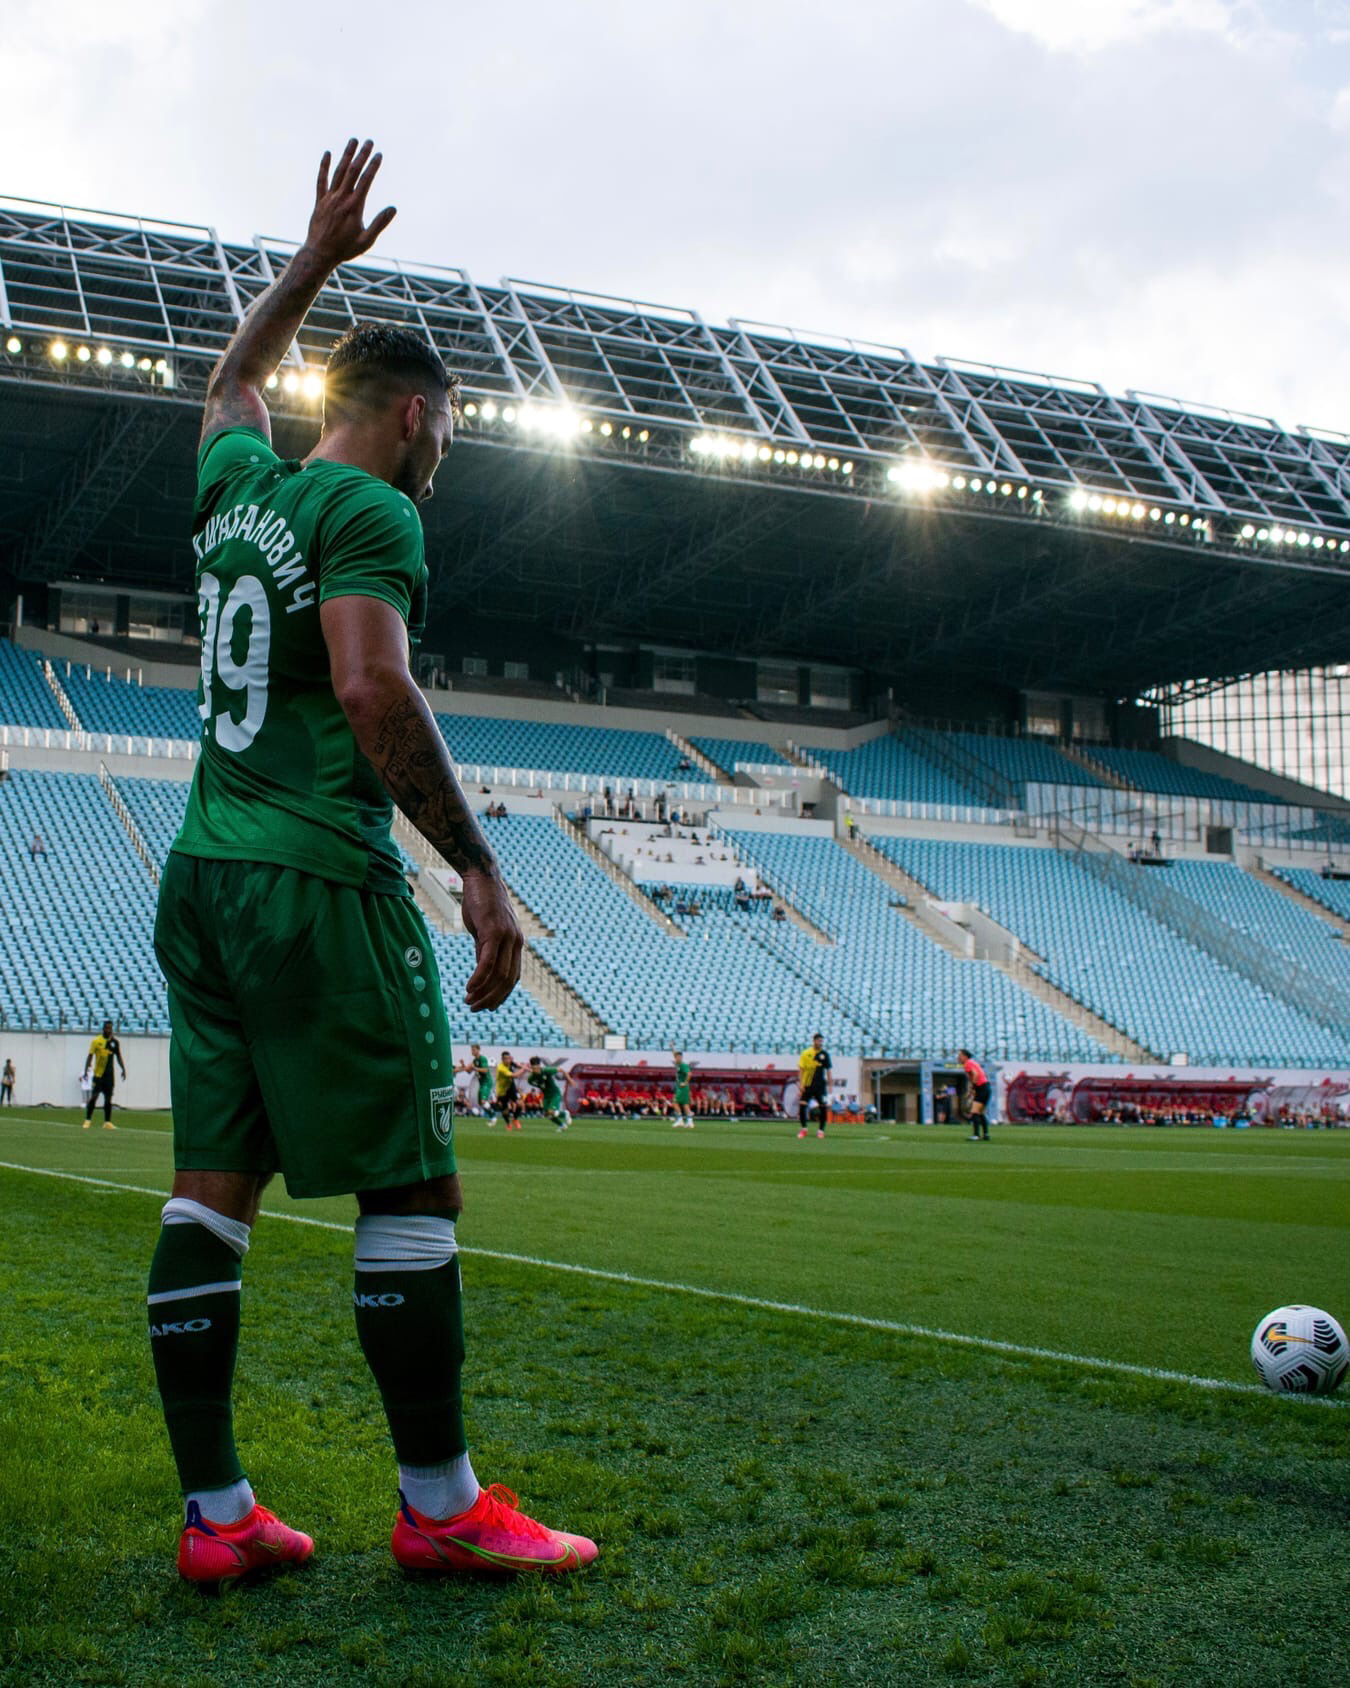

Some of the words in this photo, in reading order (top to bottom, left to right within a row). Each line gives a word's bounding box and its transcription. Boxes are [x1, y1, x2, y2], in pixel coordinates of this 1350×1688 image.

[193, 503, 316, 614] КШАБАНОВИЧ
[374, 725, 393, 754] GET
[148, 1318, 212, 1338] AKO
